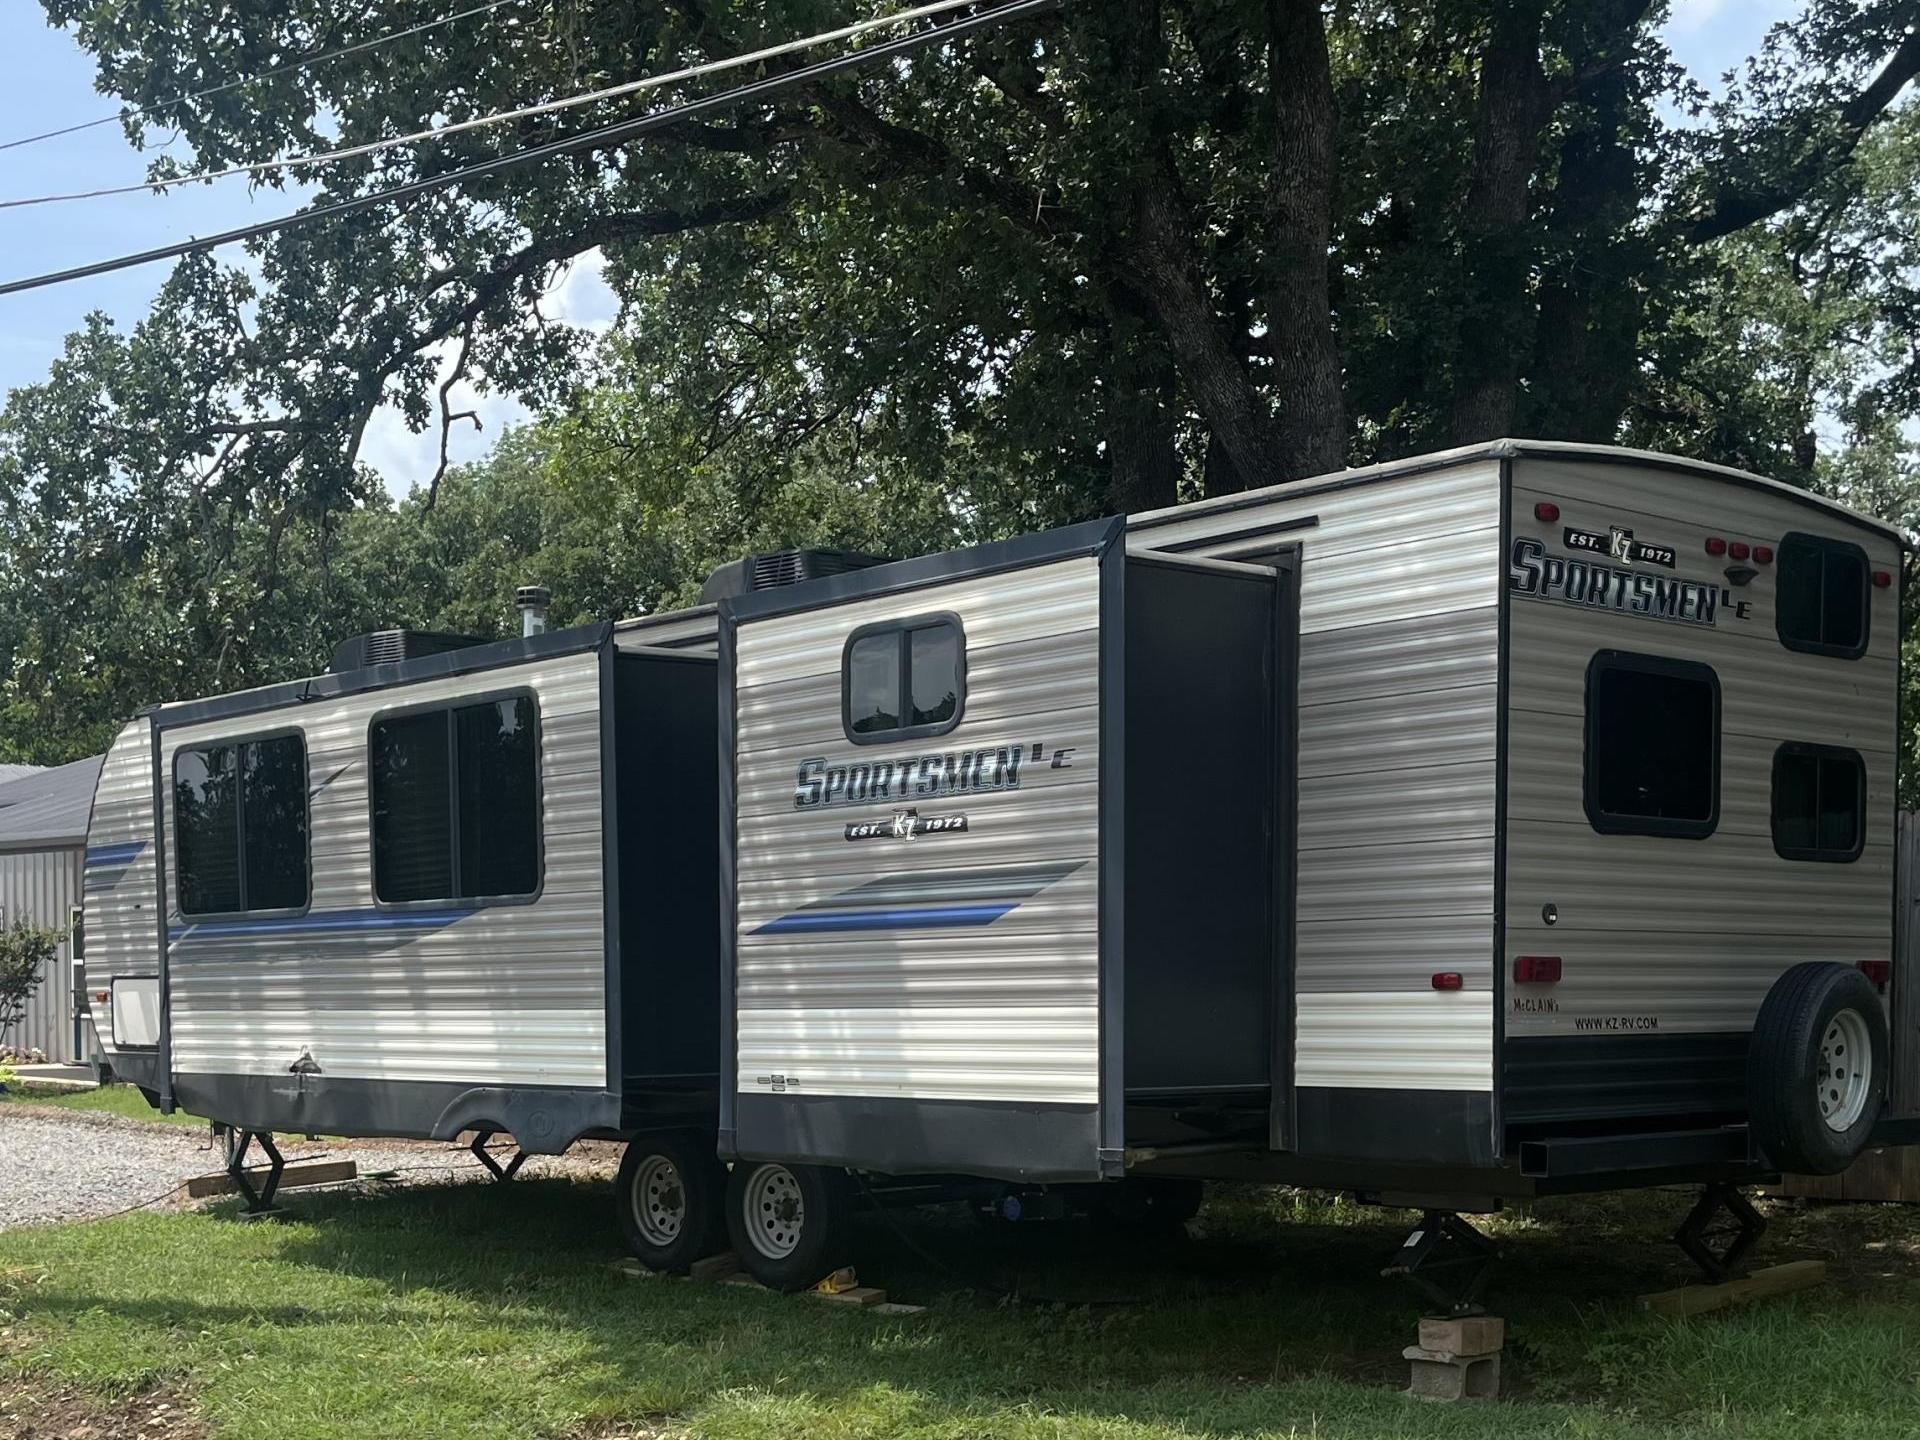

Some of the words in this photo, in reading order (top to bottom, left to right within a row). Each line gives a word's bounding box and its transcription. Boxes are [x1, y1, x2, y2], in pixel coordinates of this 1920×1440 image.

[1569, 533, 1599, 549] EST.
[1611, 530, 1631, 565] KZ
[1640, 547, 1672, 562] 1972
[1510, 538, 1718, 625] SPORTSMEN
[1721, 589, 1753, 620] LE
[794, 744, 1024, 810] SPORTSMEN
[850, 826, 881, 837] EST.
[893, 812, 917, 841] KZ
[926, 817, 963, 830] 1972
[1575, 1017, 1659, 1030] WWW.KZ-RV.COM
